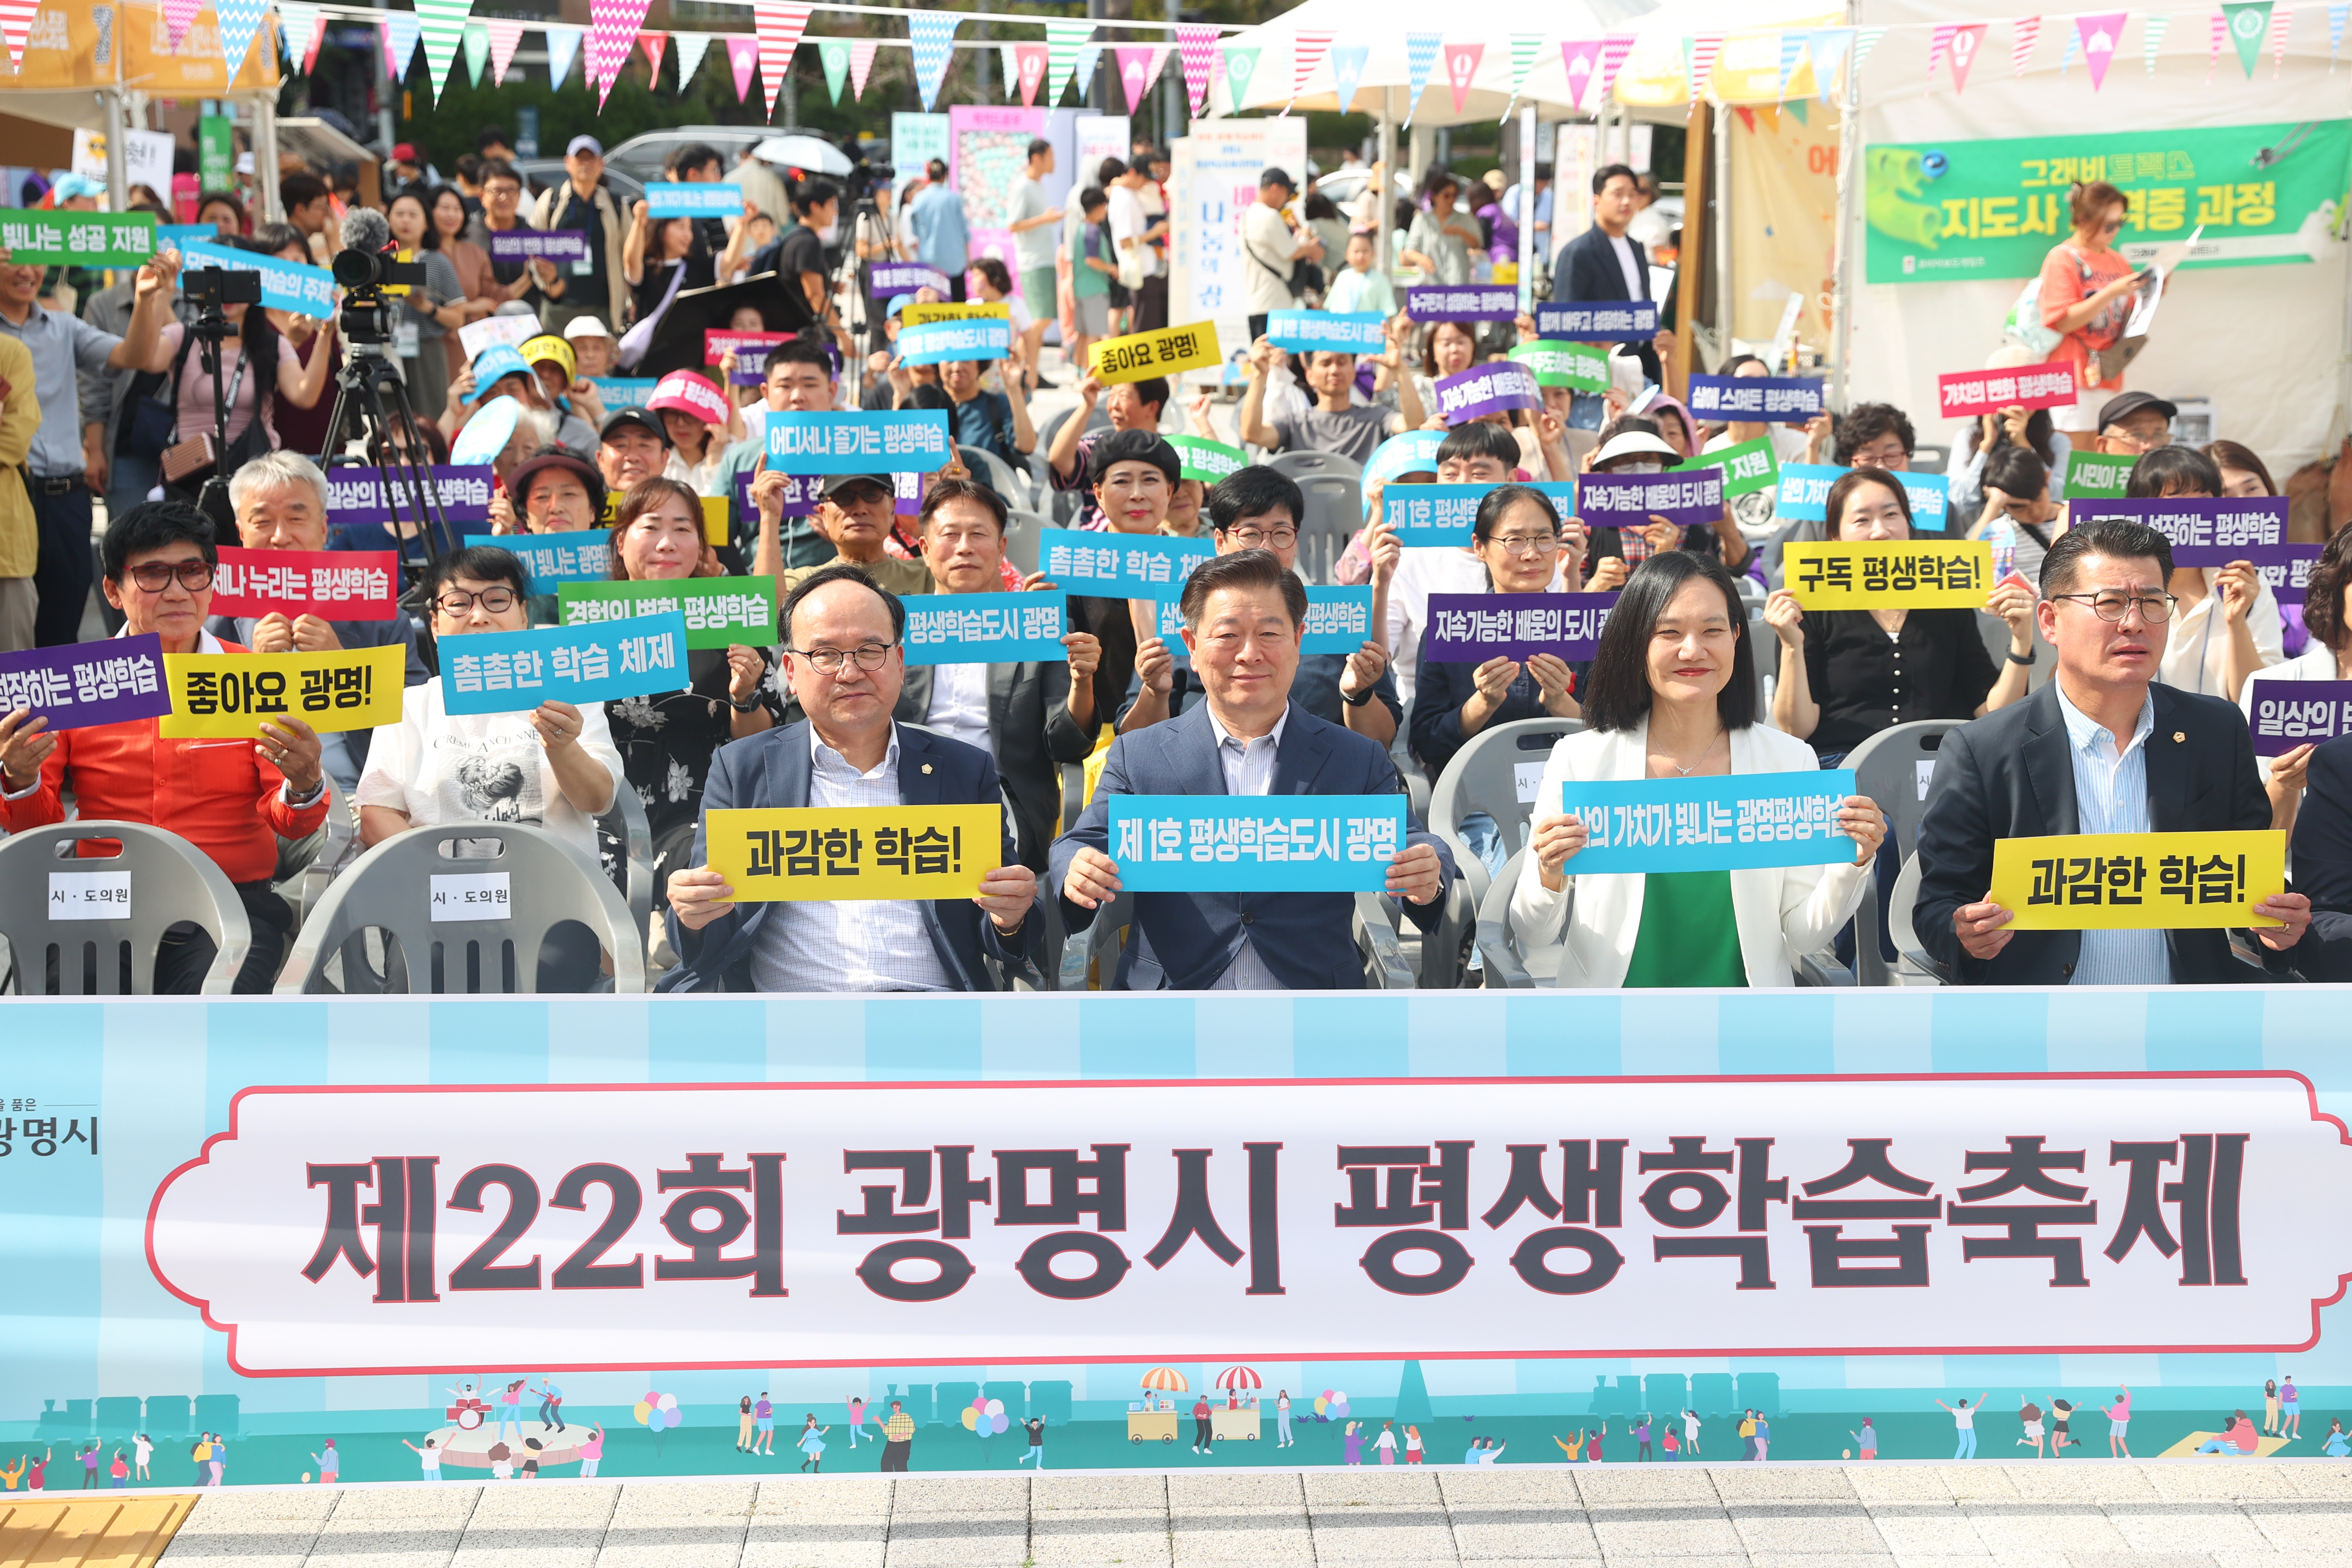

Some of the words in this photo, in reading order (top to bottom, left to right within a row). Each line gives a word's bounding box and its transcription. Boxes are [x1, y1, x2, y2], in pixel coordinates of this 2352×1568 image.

[1941, 194, 2059, 239] 지도사
[2195, 182, 2276, 226] 과정
[2, 222, 62, 251] 빛나는
[67, 223, 107, 253] 성공
[111, 225, 151, 254] 지원
[1561, 311, 1592, 332] 배우고
[1593, 309, 1633, 332] 성장하는
[1634, 309, 1655, 331] 광명
[1101, 343, 1154, 374] 좋아요
[1157, 332, 1199, 362] 광명!
[1692, 386, 1720, 409] 삶에
[1721, 388, 1763, 412] 스며든
[1764, 389, 1820, 413] 평생학습
[1942, 380, 1986, 406] 가치의
[1986, 377, 2017, 402] 변화
[2018, 371, 2074, 399] 평생학습
[771, 425, 831, 456] 어디서나
[834, 425, 880, 454] 즐기는
[883, 423, 944, 453] 평생학습
[1731, 449, 1770, 478] 지원
[2071, 463, 2116, 490] 시민이
[327, 481, 376, 511] 일상의
[420, 478, 489, 507] 평생학습
[1583, 485, 1644, 513] 지속가능한
[1645, 484, 1681, 510] 배움의
[1681, 482, 1702, 508] 도시
[1703, 479, 1721, 506] 광명
[1781, 477, 1804, 503] 삶의
[2216, 512, 2281, 547] 평생학습
[535, 546, 578, 578] 빛나는
[1049, 545, 1120, 580] 촘촘한
[1126, 549, 1171, 583] 학습
[1799, 557, 1852, 592] 구독
[1863, 555, 1981, 592] 평생학습!
[249, 566, 307, 601] 누리는
[311, 568, 389, 601] 평생학습
[684, 593, 768, 630] 평생학습
[908, 608, 1020, 644] 평생학습도시
[1023, 606, 1060, 641] 광명
[1435, 611, 1514, 642] 지속가능한
[1515, 609, 1562, 642] 배움의
[1564, 609, 1596, 641] 도시
[74, 653, 159, 703] 평생학습
[452, 650, 544, 693] 촘촘한
[552, 643, 609, 683] 학습
[618, 632, 676, 675] 체제
[187, 671, 288, 715] 좋아요
[300, 665, 372, 712] 광명!
[2259, 700, 2336, 738] 일상의
[1614, 803, 1673, 848] 가치가
[1675, 799, 1733, 845] 빛나는
[1737, 794, 1847, 844] 광명평생학습
[746, 827, 862, 877] 과감한
[874, 826, 961, 875] 학습!
[1189, 817, 1339, 862] 평생학습도시
[1347, 817, 1397, 861] 광명
[51, 890, 65, 904] 시
[84, 888, 128, 903] 도의원
[433, 890, 446, 906] 시
[464, 888, 509, 905] 도의원
[2027, 855, 2146, 906] 과감한
[2159, 854, 2246, 905] 학습!
[11, 1098, 37, 1112] 품은
[301, 1153, 789, 1304] 제22회
[837, 1141, 1286, 1302] 광명시
[1333, 1133, 2251, 1296] 평생학습축제
